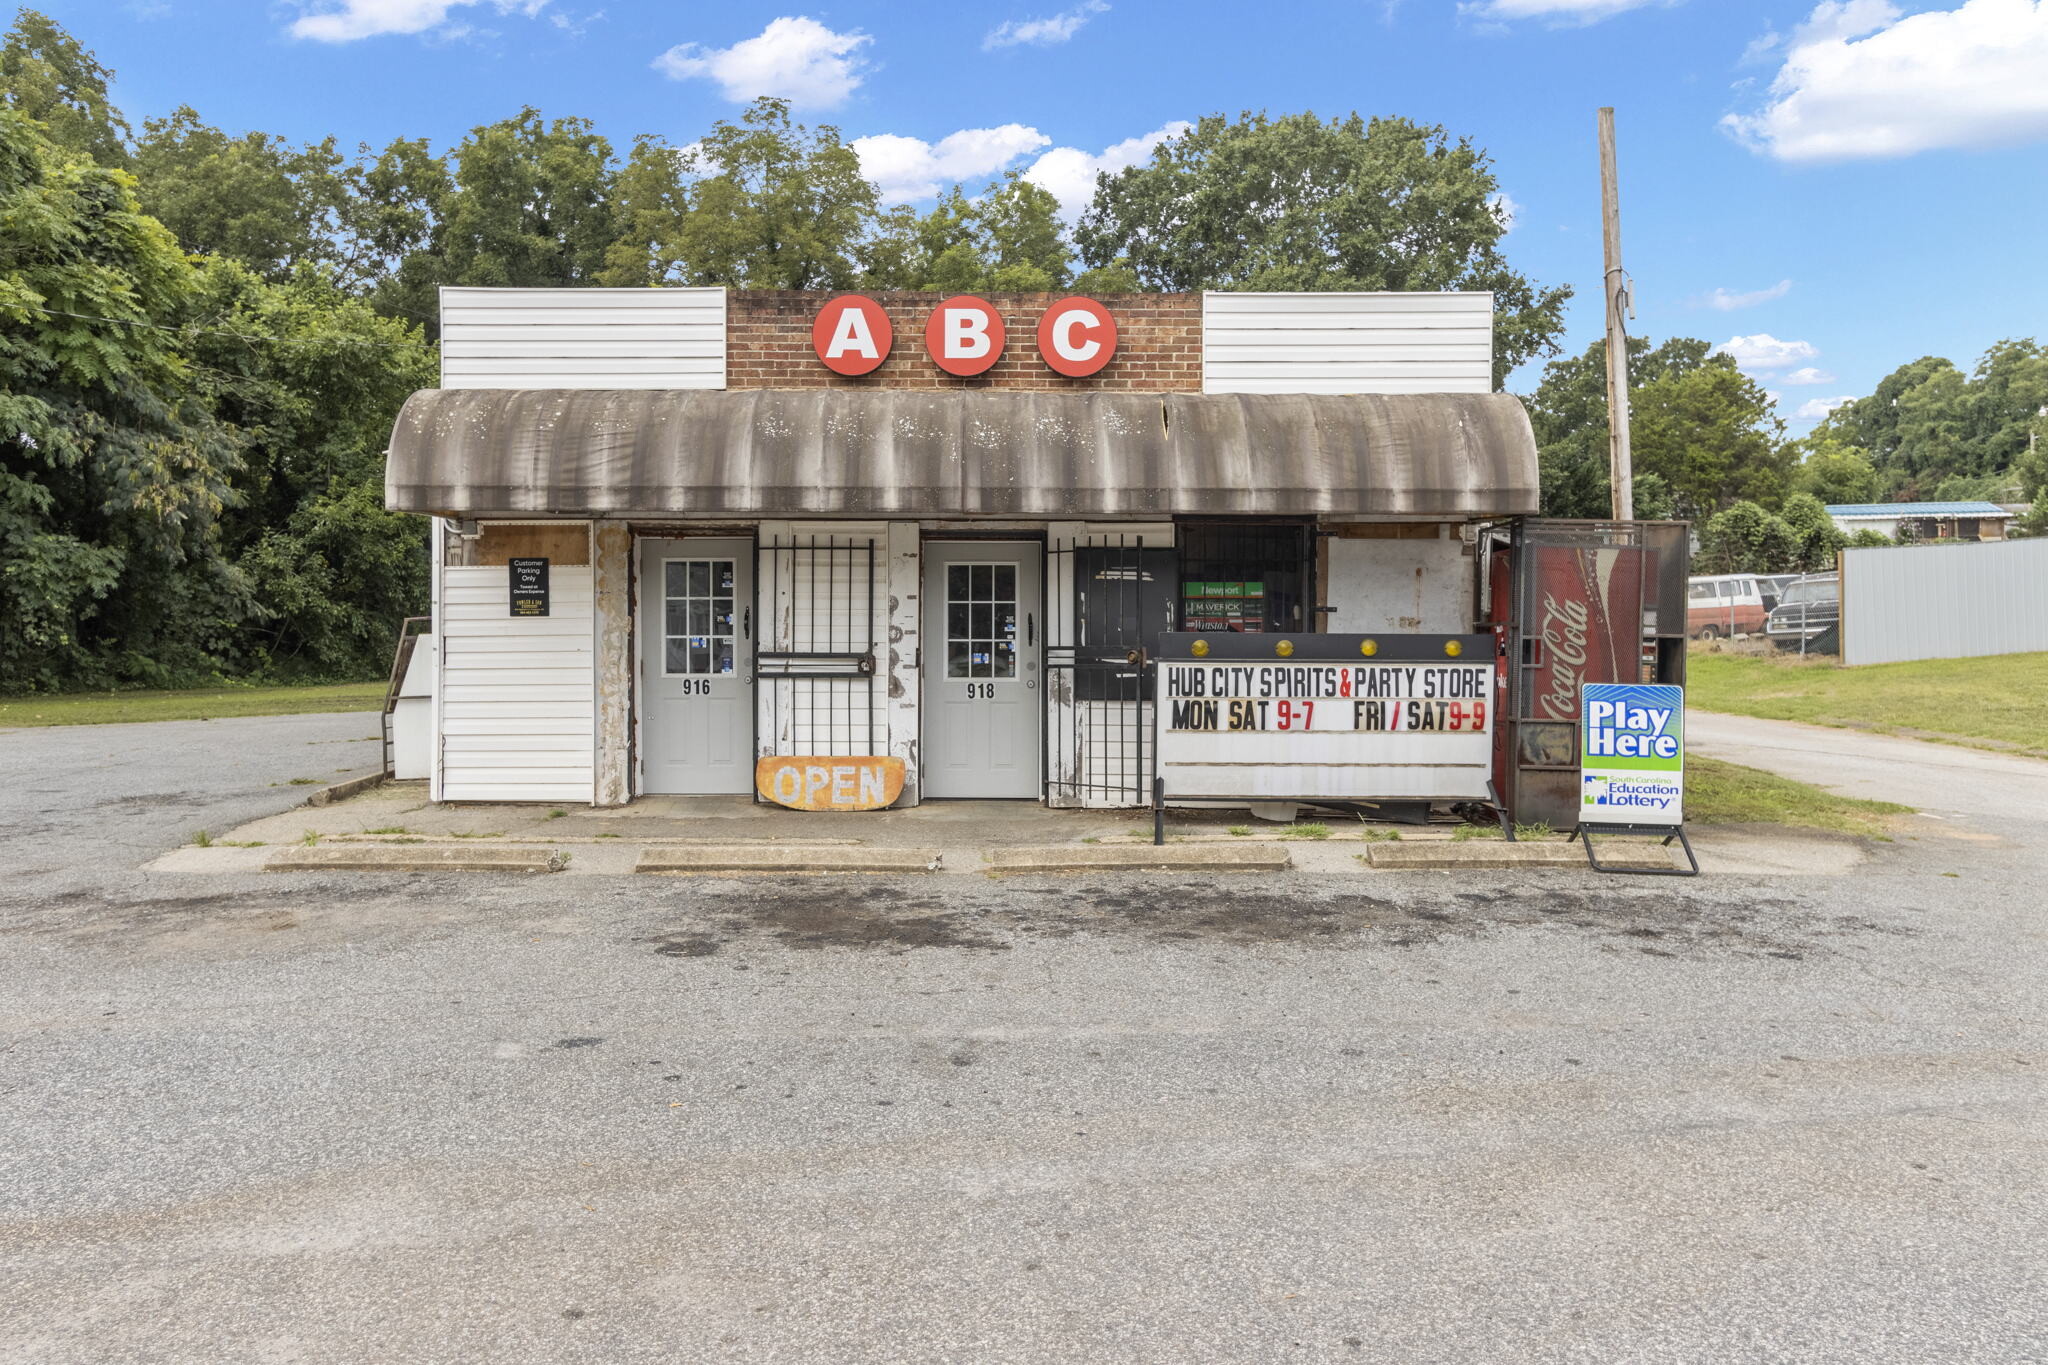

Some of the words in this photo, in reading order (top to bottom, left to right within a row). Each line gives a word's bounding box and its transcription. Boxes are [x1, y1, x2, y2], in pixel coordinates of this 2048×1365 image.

[825, 307, 879, 359] A
[944, 308, 991, 359] B
[1052, 309, 1101, 362] C
[517, 567, 540, 575] Parking
[683, 679, 710, 695] 916
[967, 683, 994, 699] 918
[1168, 667, 1205, 697] HUB
[1212, 667, 1254, 697] CITY
[1260, 667, 1336, 698] SPIRITS
[1340, 668, 1351, 697] &
[1354, 667, 1416, 698] PARTY
[1424, 668, 1487, 698] STORE
[1172, 700, 1218, 730] MON
[1229, 700, 1269, 730] SAT
[1277, 700, 1314, 730] 9-7
[1354, 701, 1385, 730] FRI
[1407, 701, 1449, 730] SAT
[1449, 702, 1486, 731] 9-9
[1588, 700, 1672, 736] Play
[1588, 727, 1677, 758] Here
[774, 765, 885, 804] OPEN
[1609, 783, 1679, 795] Education
[1636, 776, 1672, 784] Carolina
[1609, 793, 1671, 809] Lottery
